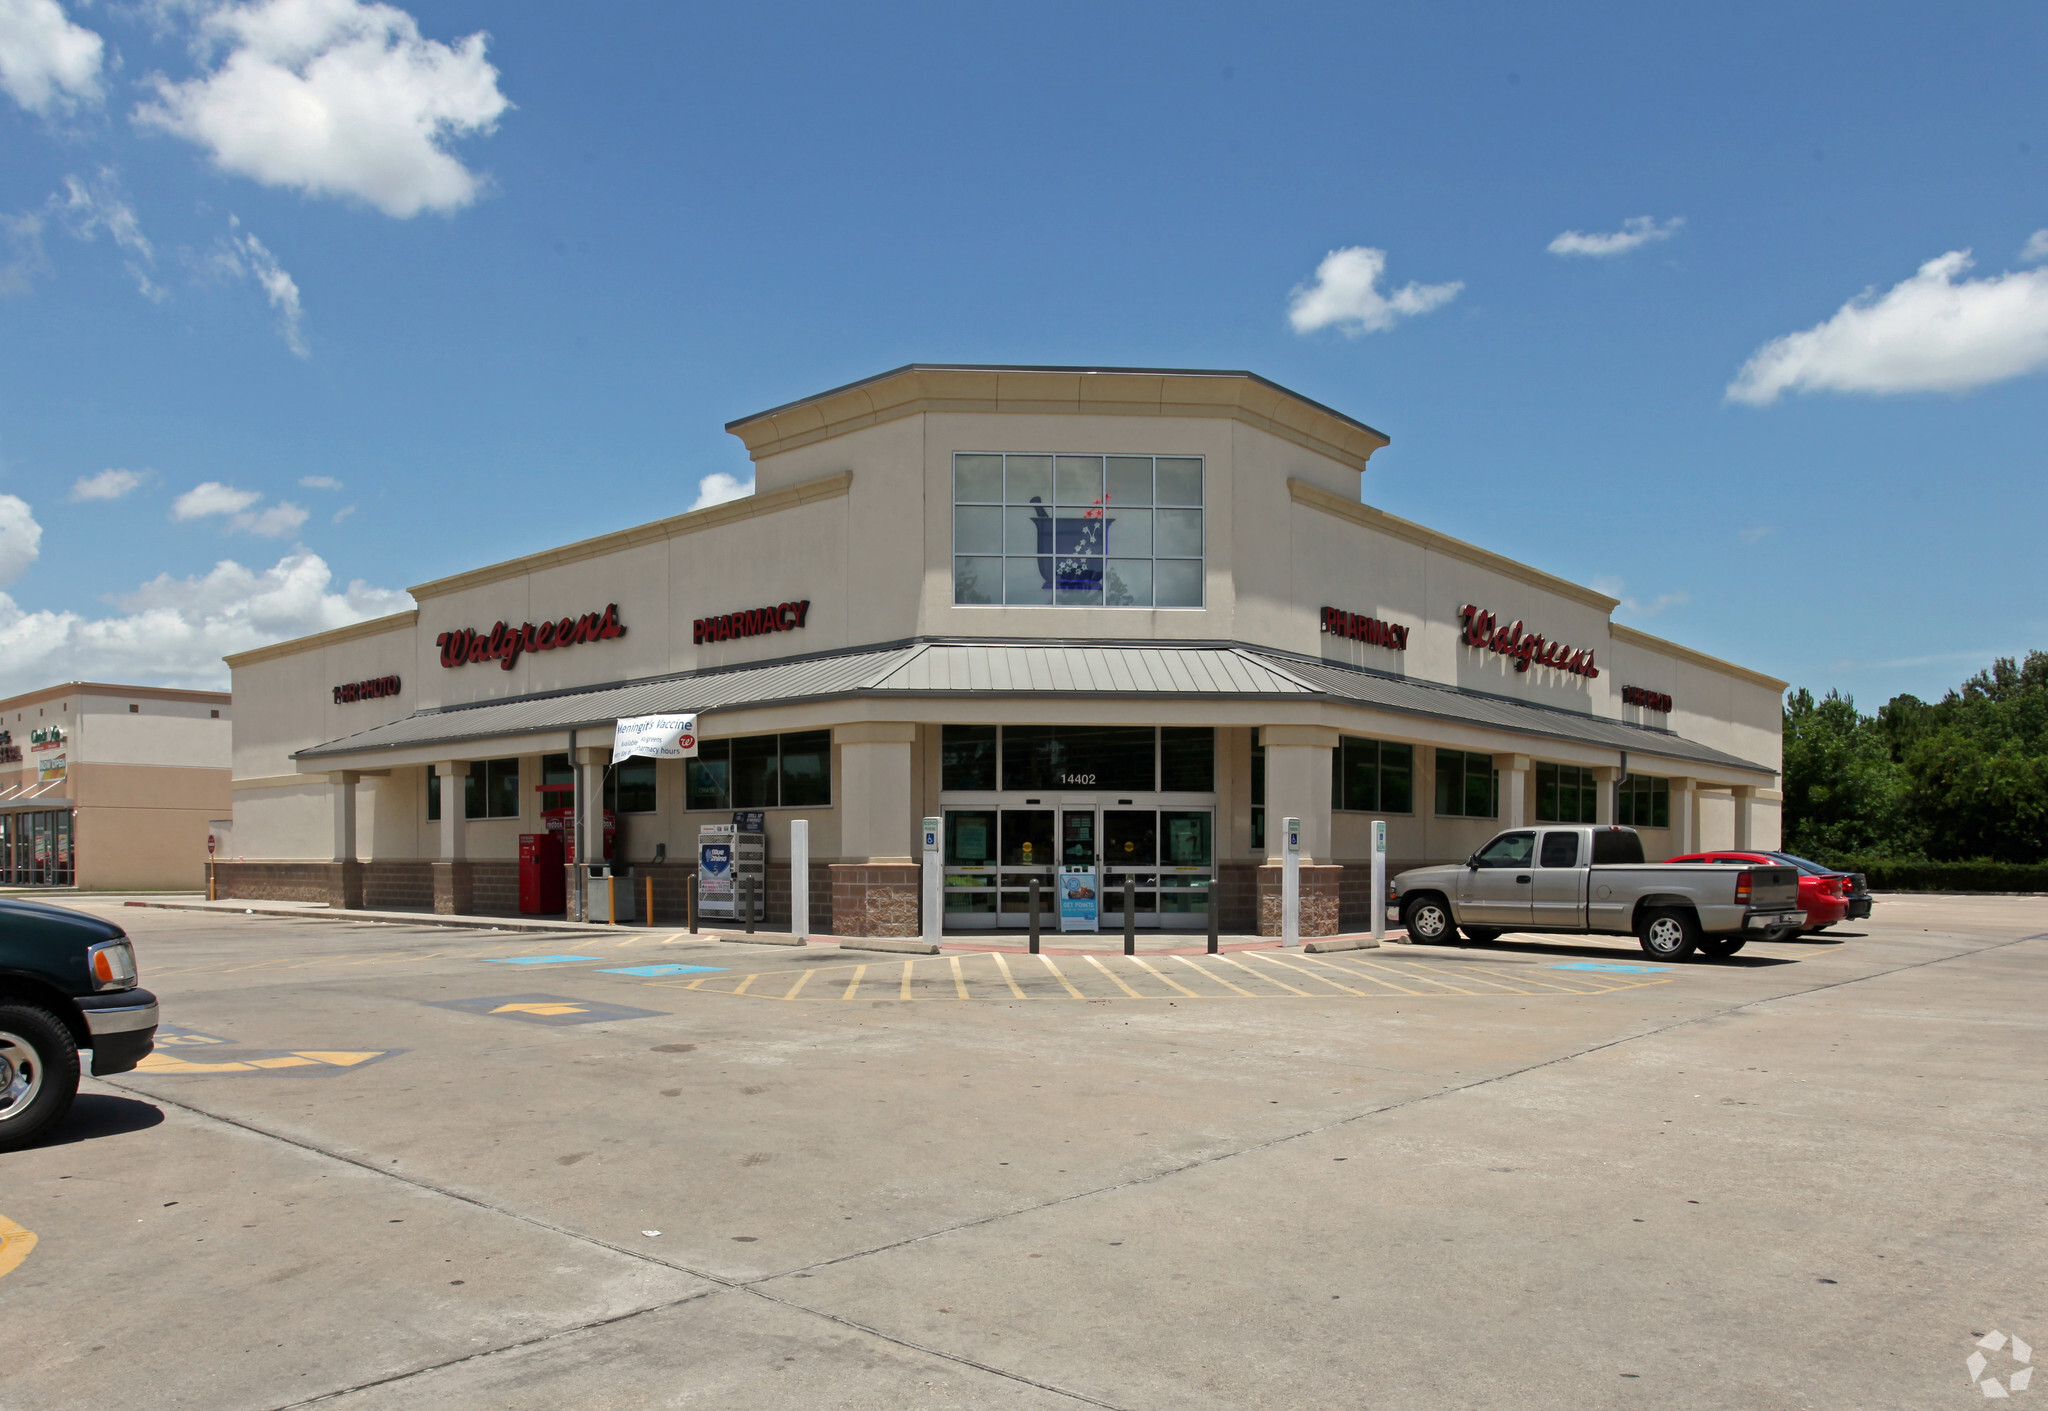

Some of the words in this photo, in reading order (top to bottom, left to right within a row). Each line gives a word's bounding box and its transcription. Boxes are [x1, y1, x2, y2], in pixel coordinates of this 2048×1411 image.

[436, 602, 628, 671] Walgreens
[693, 600, 810, 645] PHARMACY
[1321, 606, 1410, 651] PHARMACY
[1458, 604, 1600, 679] Walgreens
[360, 675, 401, 700] PHOTO
[656, 720, 692, 731] Vaccine
[1061, 774, 1096, 784] 14402
